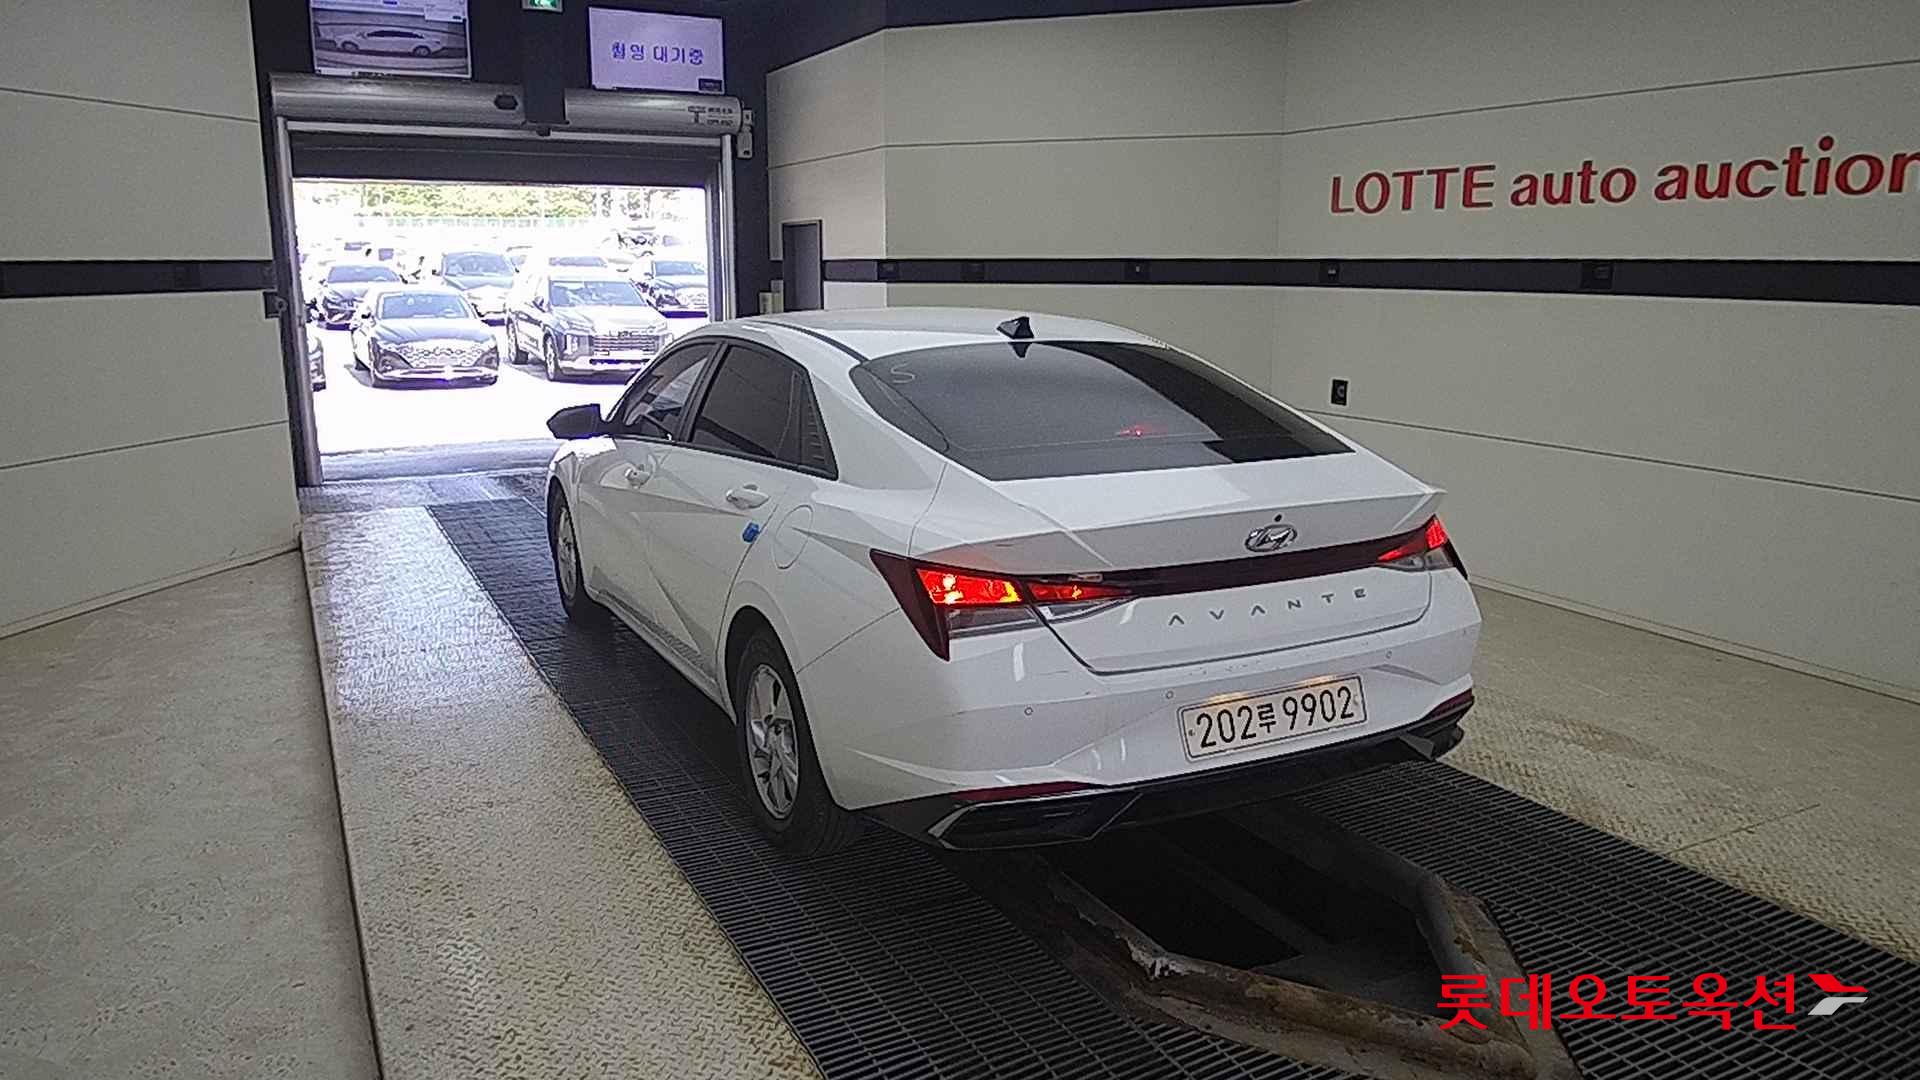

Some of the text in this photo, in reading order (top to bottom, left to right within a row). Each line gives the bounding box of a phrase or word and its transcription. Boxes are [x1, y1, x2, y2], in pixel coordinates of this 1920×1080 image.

[1331, 163, 1496, 214] LOTTE
[1511, 160, 1637, 207] auto
[1169, 588, 1367, 626] AVANTE
